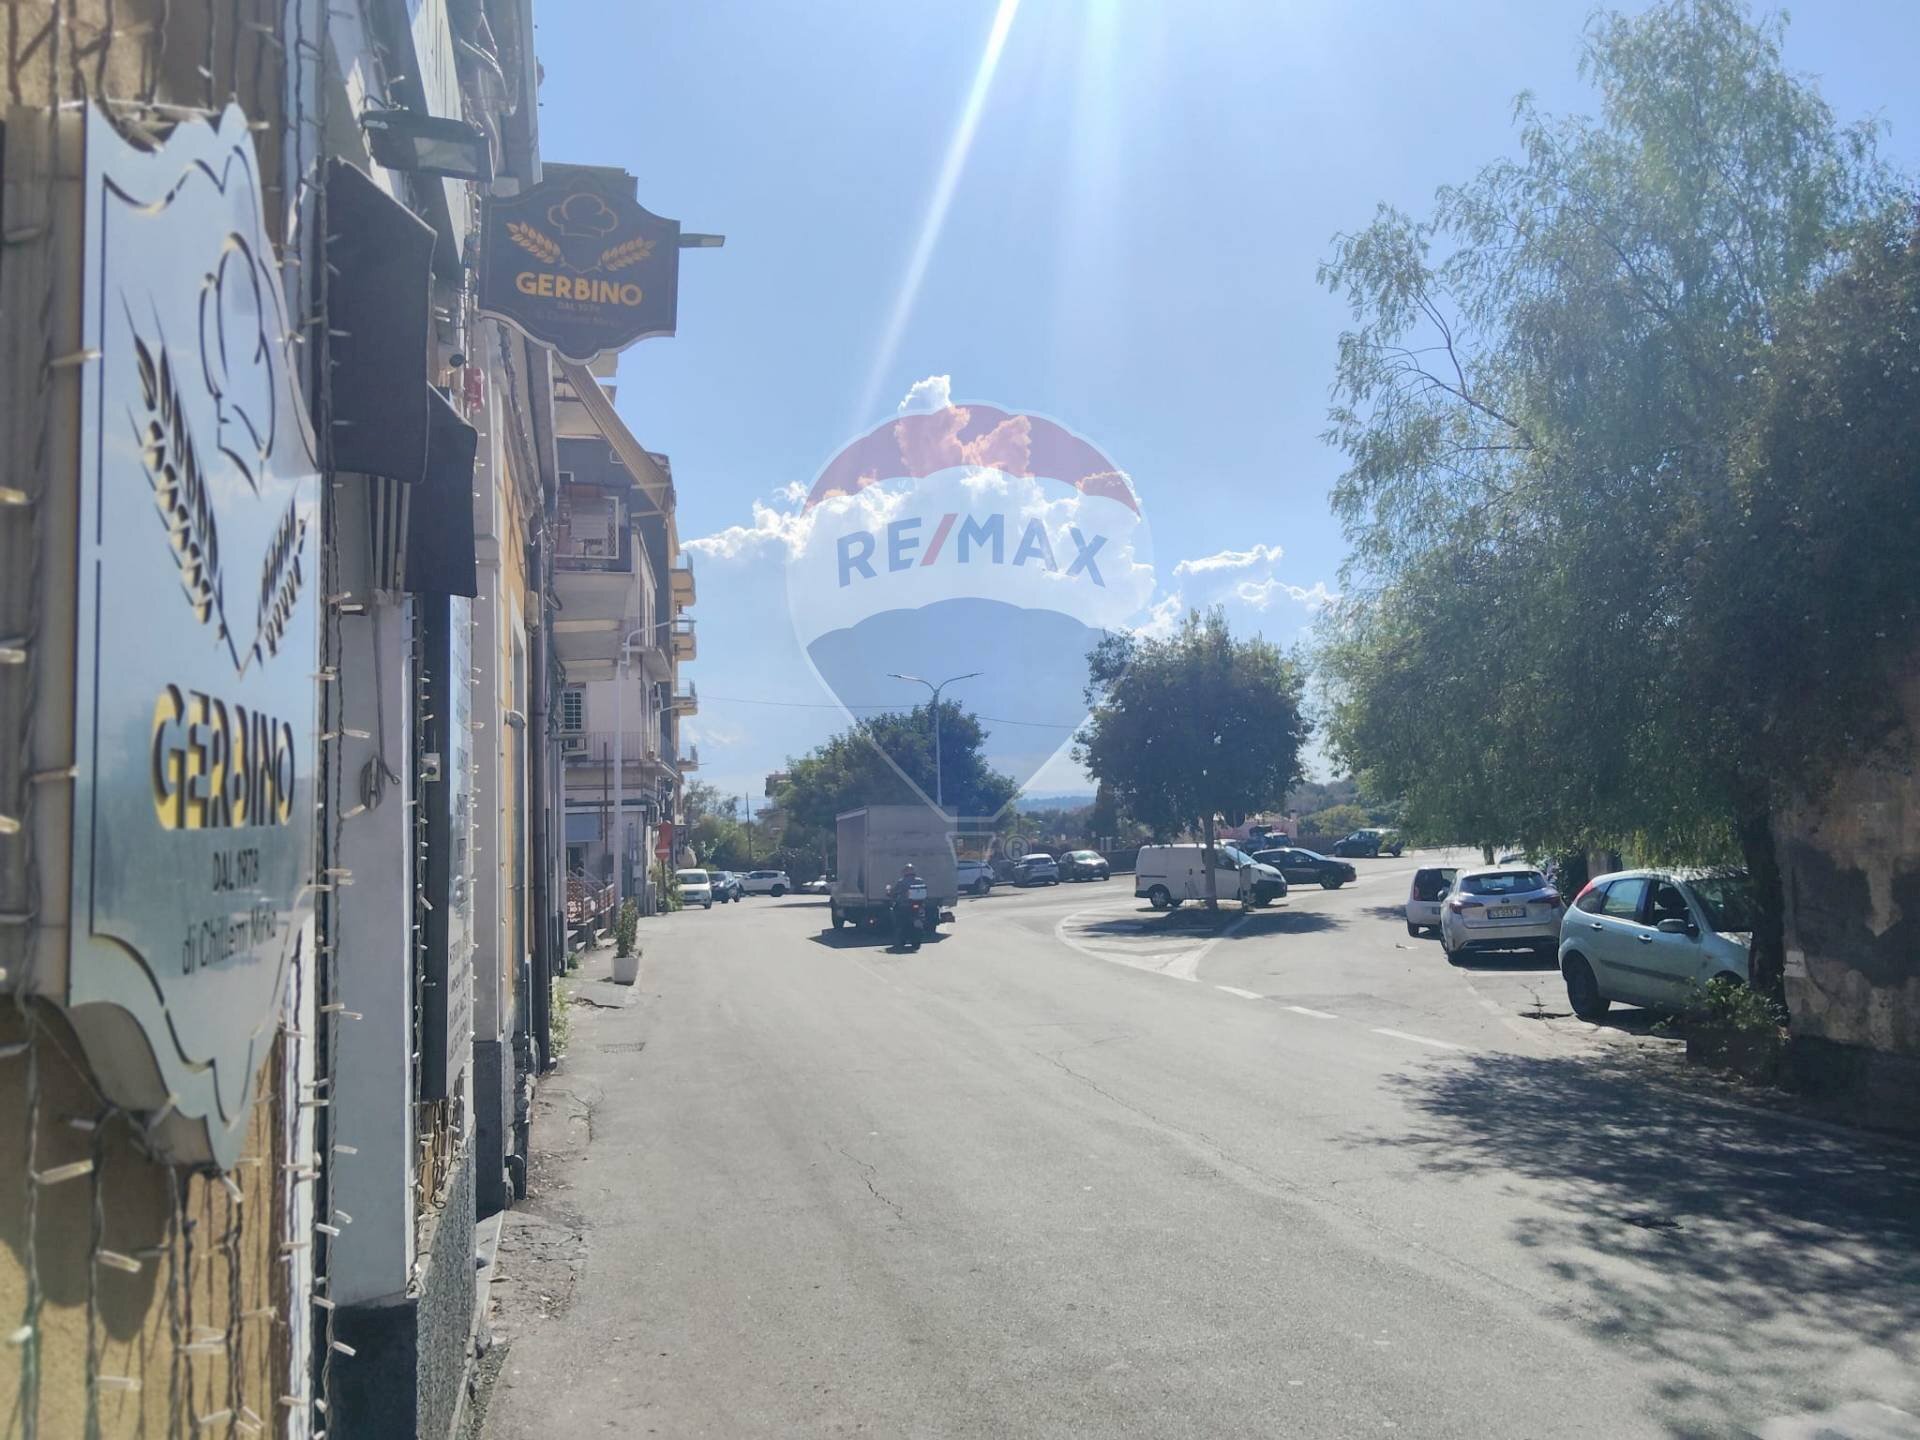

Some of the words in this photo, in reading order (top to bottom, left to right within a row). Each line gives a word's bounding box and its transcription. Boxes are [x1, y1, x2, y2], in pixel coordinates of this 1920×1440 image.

[515, 271, 643, 306] GERBINO
[152, 683, 295, 831] GERBINO
[212, 850, 235, 891] DAL
